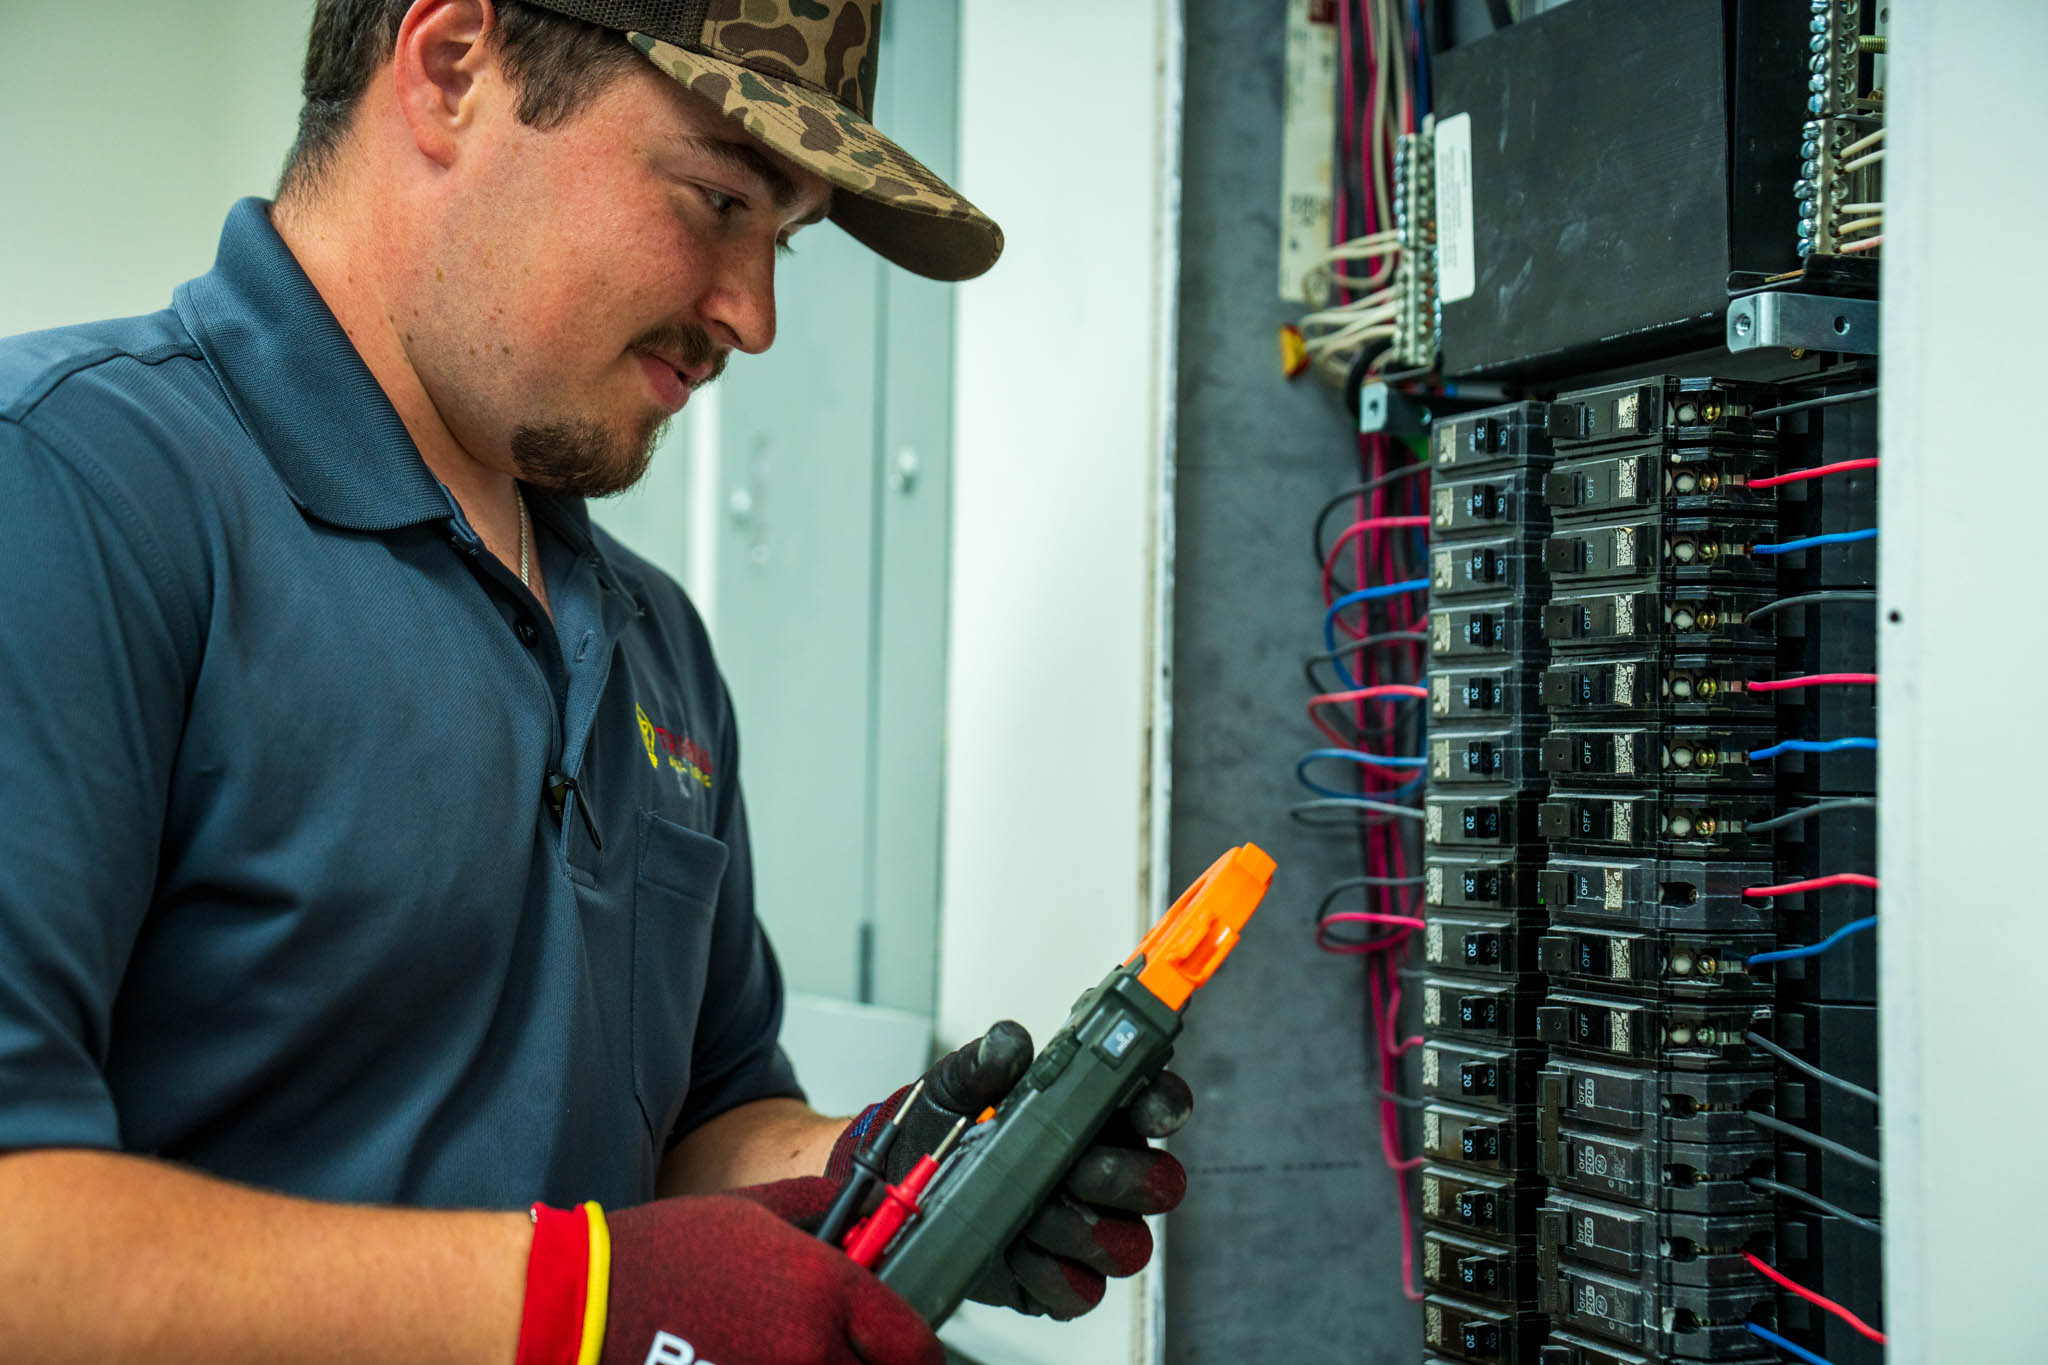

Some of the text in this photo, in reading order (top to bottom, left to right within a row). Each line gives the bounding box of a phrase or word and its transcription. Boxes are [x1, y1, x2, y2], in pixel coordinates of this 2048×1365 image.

[1477, 427, 1485, 440] 20
[1587, 475, 1595, 499] OFF
[1475, 495, 1483, 507] 20
[1587, 541, 1595, 564] OFF
[1474, 556, 1482, 569] 20
[1497, 560, 1504, 575] ON
[1473, 621, 1480, 634] 20
[1584, 607, 1592, 631] OFF
[1496, 625, 1503, 640] ON
[1471, 688, 1479, 700] 20
[1494, 688, 1501, 703] ON
[1583, 675, 1591, 699] OFF
[1471, 752, 1479, 764] 20
[1494, 753, 1501, 768] ON
[1584, 741, 1592, 765] OFF
[1466, 816, 1475, 829] 20
[1489, 814, 1496, 831] ON
[1583, 809, 1591, 833] OFF
[1466, 879, 1475, 893] 20
[1490, 878, 1497, 895] ON
[1581, 877, 1589, 896] OFF
[1468, 944, 1477, 957] 20
[1491, 940, 1498, 958] ON
[1582, 943, 1591, 968] OFF
[1464, 1008, 1472, 1021] 20
[1488, 1005, 1495, 1022] ON
[1581, 1012, 1589, 1037] OFF
[1464, 1074, 1472, 1088] 20
[1488, 1069, 1495, 1087] ON
[1586, 1081, 1594, 1105] 20A
[1464, 1140, 1472, 1153] 20
[1489, 1137, 1496, 1155] ON
[1586, 1148, 1594, 1173] 20A
[1463, 1203, 1472, 1217] 20
[1485, 1202, 1493, 1219] ON
[1585, 1219, 1593, 1245] 20A
[1464, 1269, 1473, 1283] 20
[1488, 1269, 1495, 1286] ON
[1586, 1287, 1595, 1313] 20A
[1466, 1334, 1475, 1349] 20
[1490, 1332, 1497, 1350] ON
